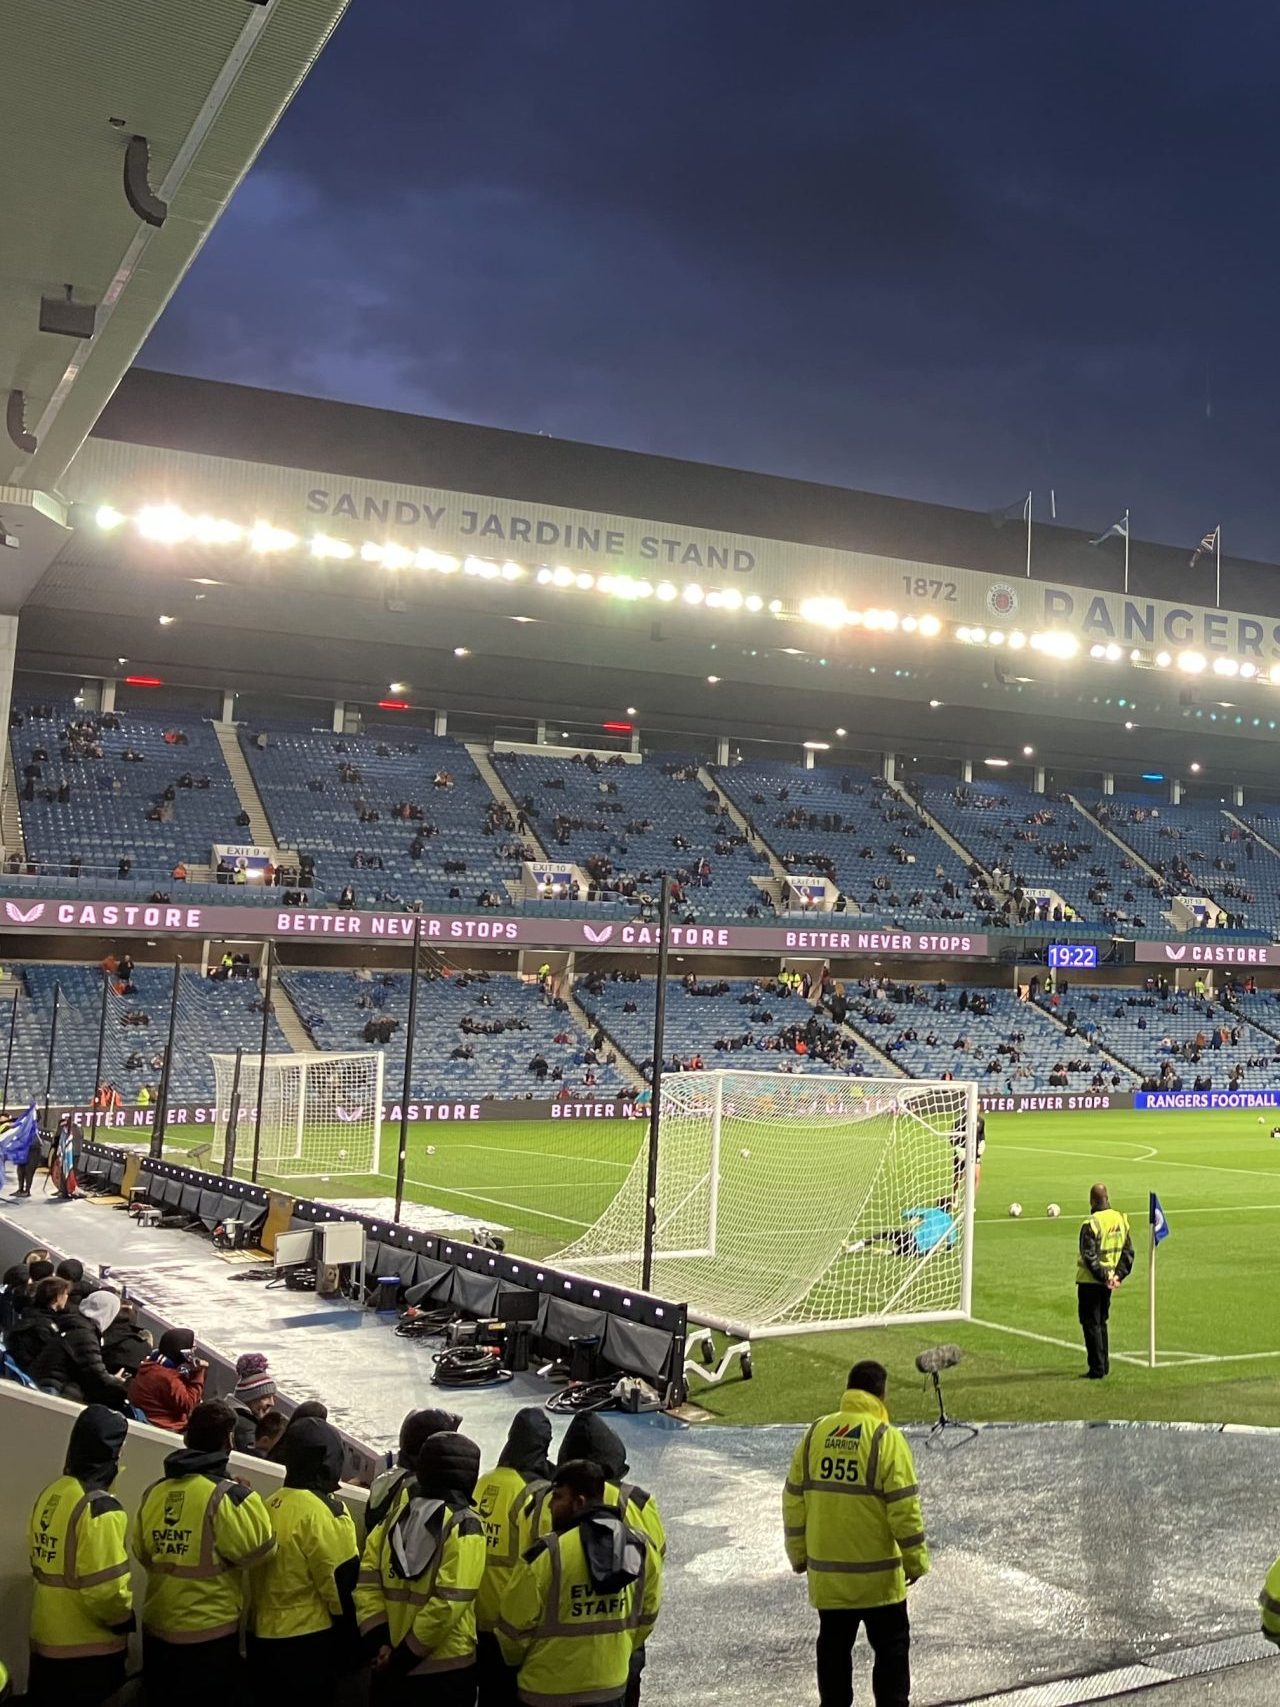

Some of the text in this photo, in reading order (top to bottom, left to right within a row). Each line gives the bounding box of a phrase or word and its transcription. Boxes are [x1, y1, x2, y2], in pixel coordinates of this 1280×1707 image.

[306, 489, 755, 573] SANDY JARDINE STAND
[902, 575, 958, 603] 1872
[227, 847, 249, 856] EXIT
[533, 864, 553, 872] EXIT
[58, 904, 201, 929] CASTORE
[277, 913, 518, 940] BETTER NEVER STOPS
[786, 932, 972, 952] BETTER NEVER STOPS
[1050, 947, 1094, 967] 19:22
[1193, 946, 1267, 963] CASTORE
[1020, 1097, 1063, 1111] NEVER
[1068, 1096, 1110, 1109] STOPS
[1146, 1094, 1208, 1108] RANGERS
[1211, 1093, 1277, 1107] FOOTBALL
[133, 1109, 187, 1125] NEER
[551, 1104, 615, 1118] BETTER
[825, 1438, 860, 1451] GARRION
[820, 1456, 859, 1482] 955
[152, 1530, 192, 1542] EVENT
[155, 1544, 190, 1556] STAFF
[572, 1598, 624, 1617] STAFF
